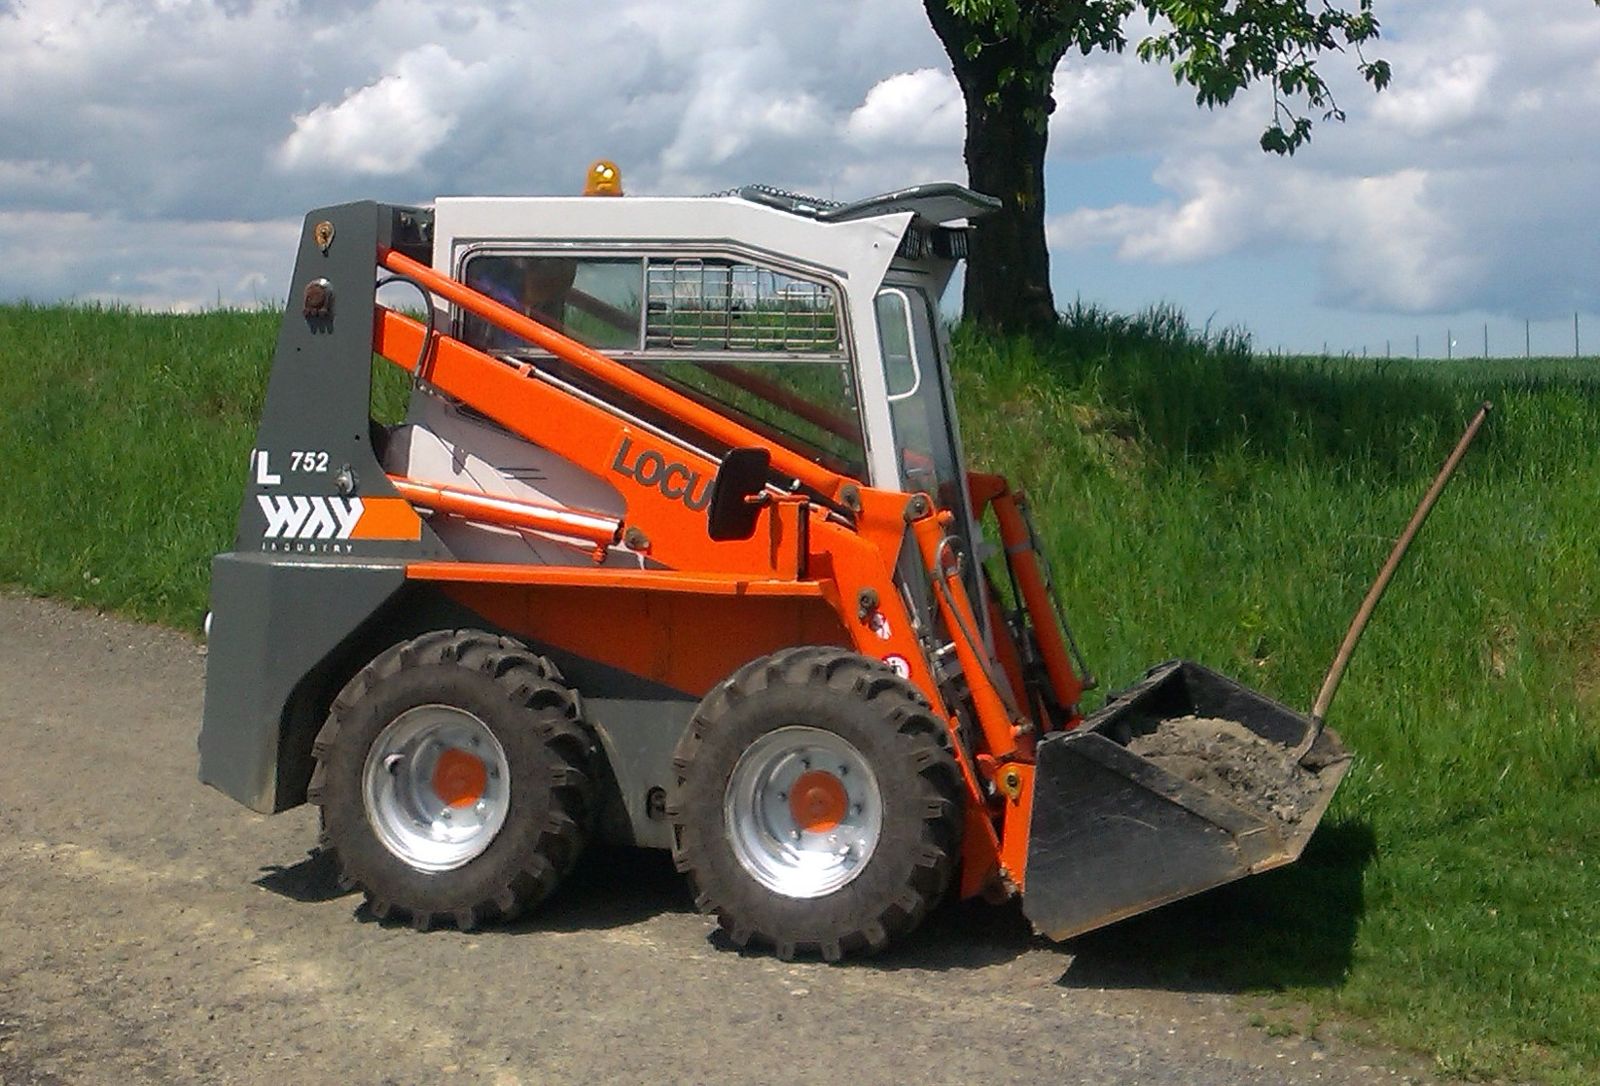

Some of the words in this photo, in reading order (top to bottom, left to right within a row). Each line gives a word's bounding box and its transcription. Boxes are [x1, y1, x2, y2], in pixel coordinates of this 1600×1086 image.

[257, 450, 281, 485] L
[291, 451, 329, 472] 752
[612, 437, 716, 511] LOCU
[256, 495, 365, 538] WAY
